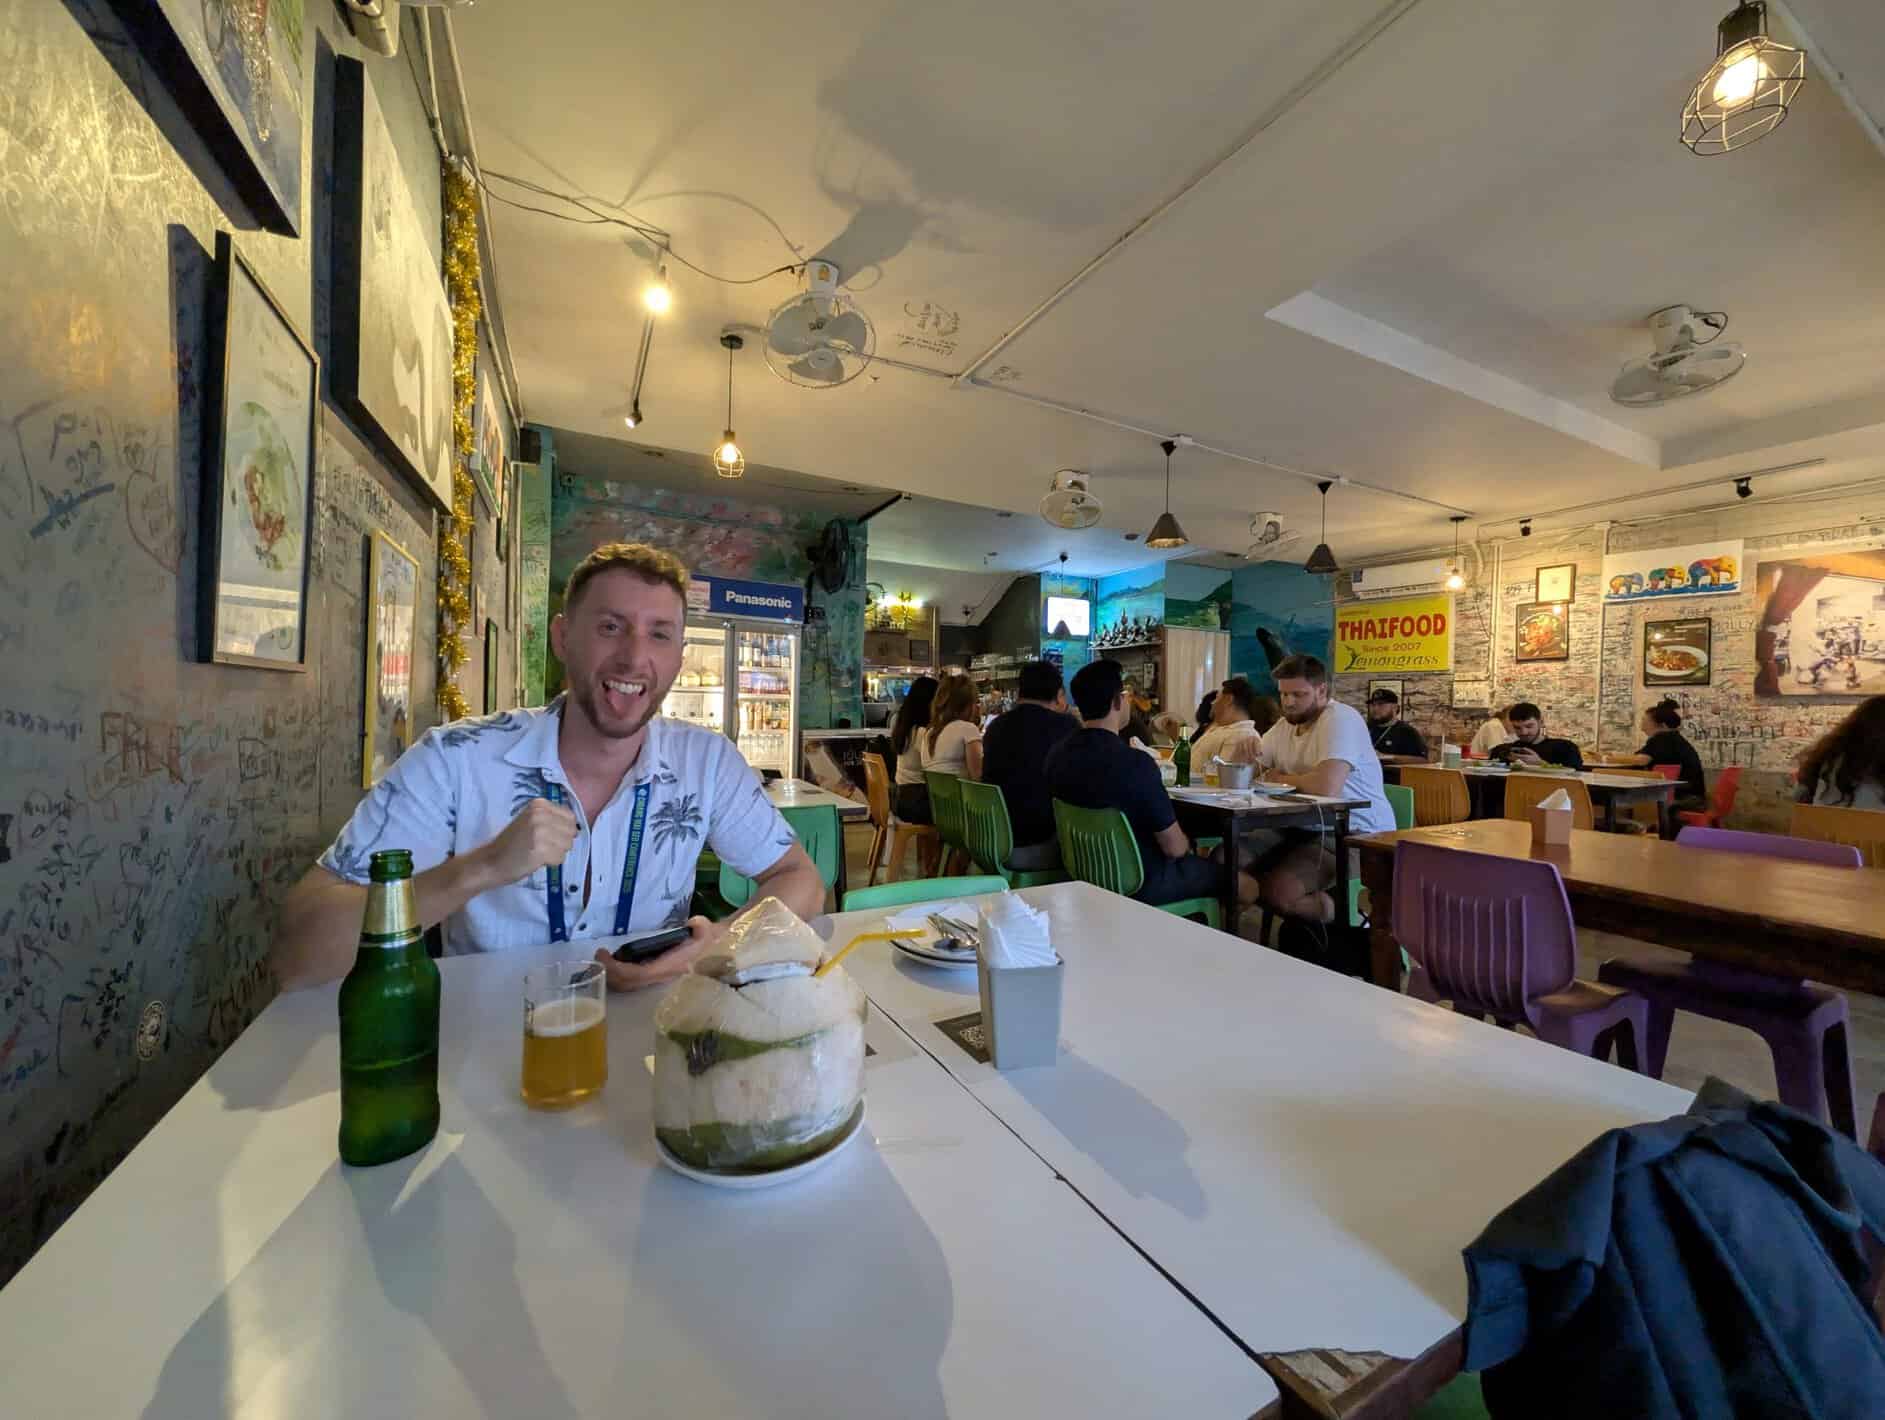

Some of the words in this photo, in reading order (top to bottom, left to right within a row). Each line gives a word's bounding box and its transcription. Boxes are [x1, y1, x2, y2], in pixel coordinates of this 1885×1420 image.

[725, 590, 793, 609] Panasonic
[1361, 644, 1389, 653] Since
[1392, 641, 1422, 652] 2007
[1344, 645, 1440, 671] Lemongrass
